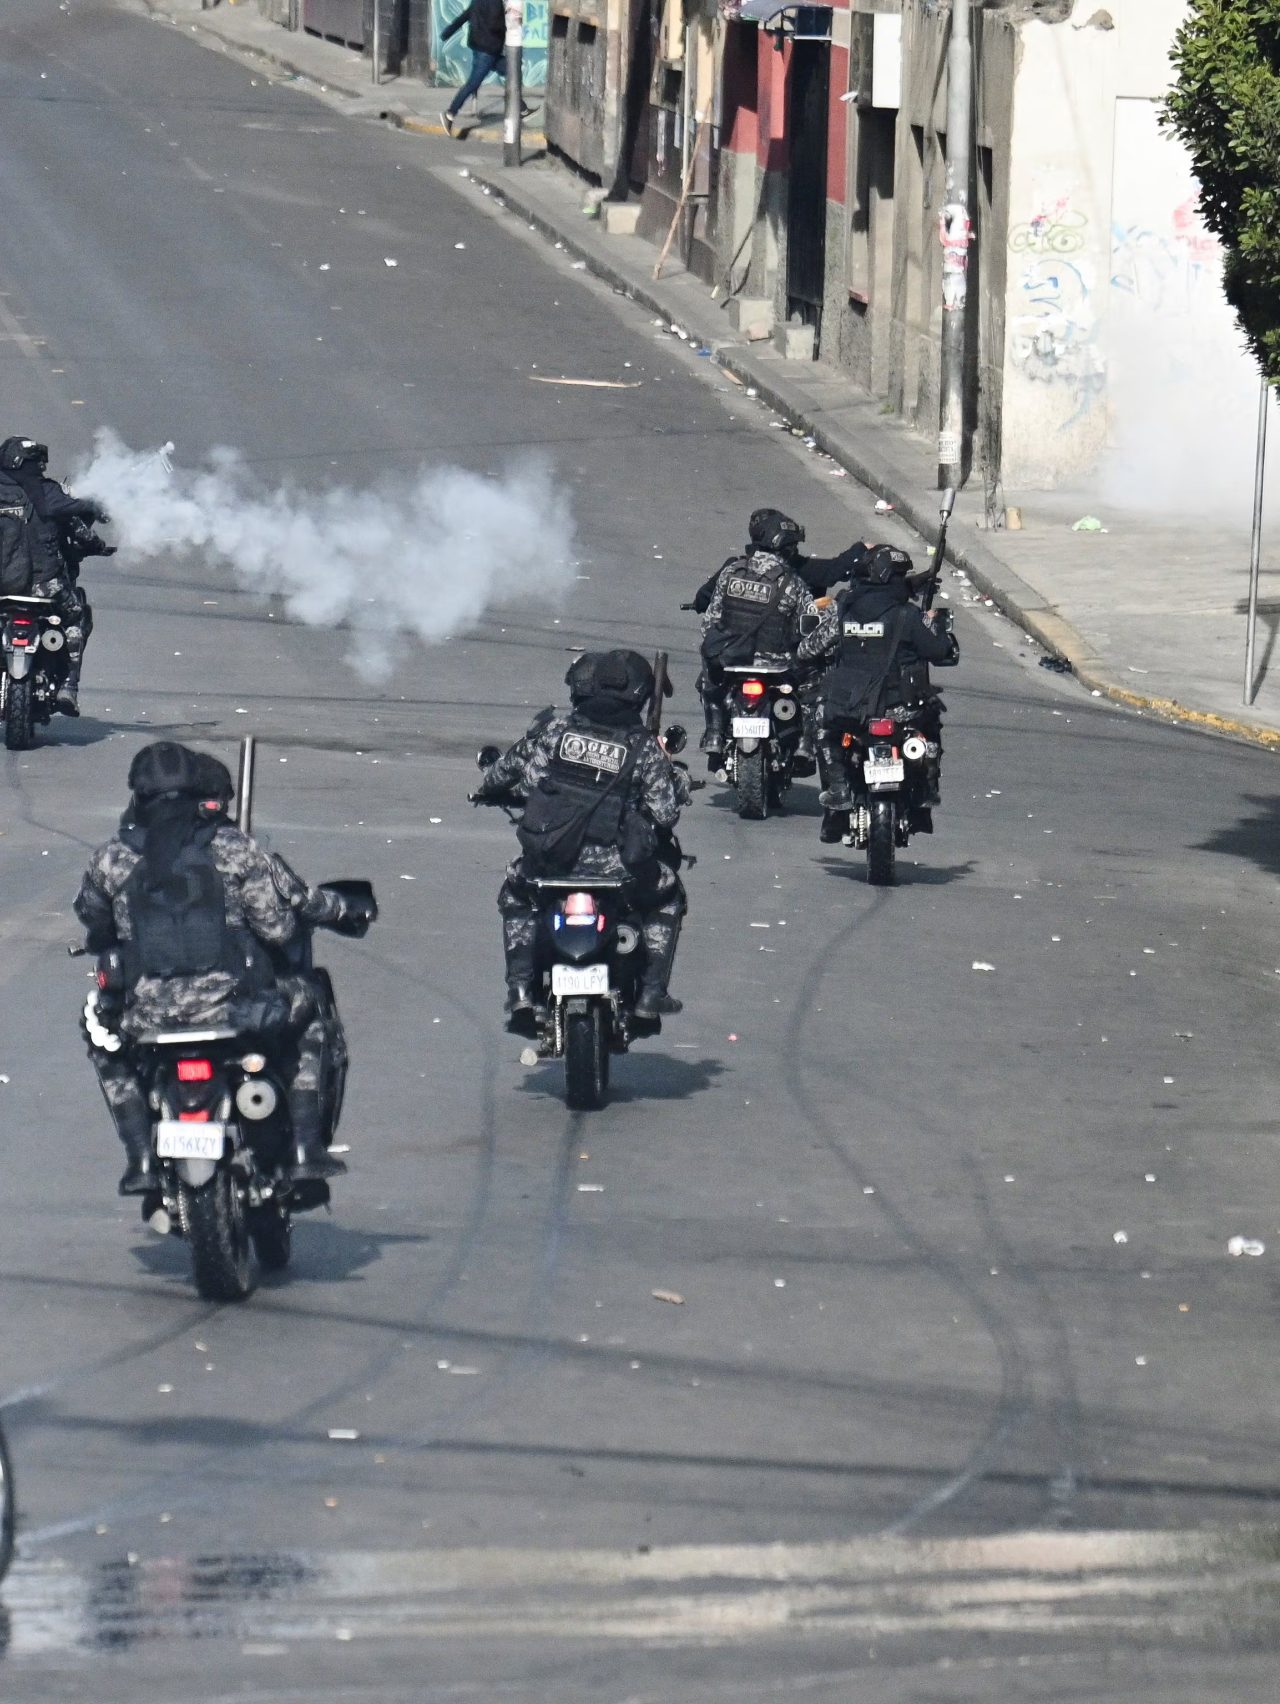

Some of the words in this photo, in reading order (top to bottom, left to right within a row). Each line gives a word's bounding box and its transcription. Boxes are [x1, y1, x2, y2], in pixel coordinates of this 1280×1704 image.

[745, 582, 767, 594] GEA
[844, 622, 884, 635] POLICIA
[587, 741, 620, 759] GEA
